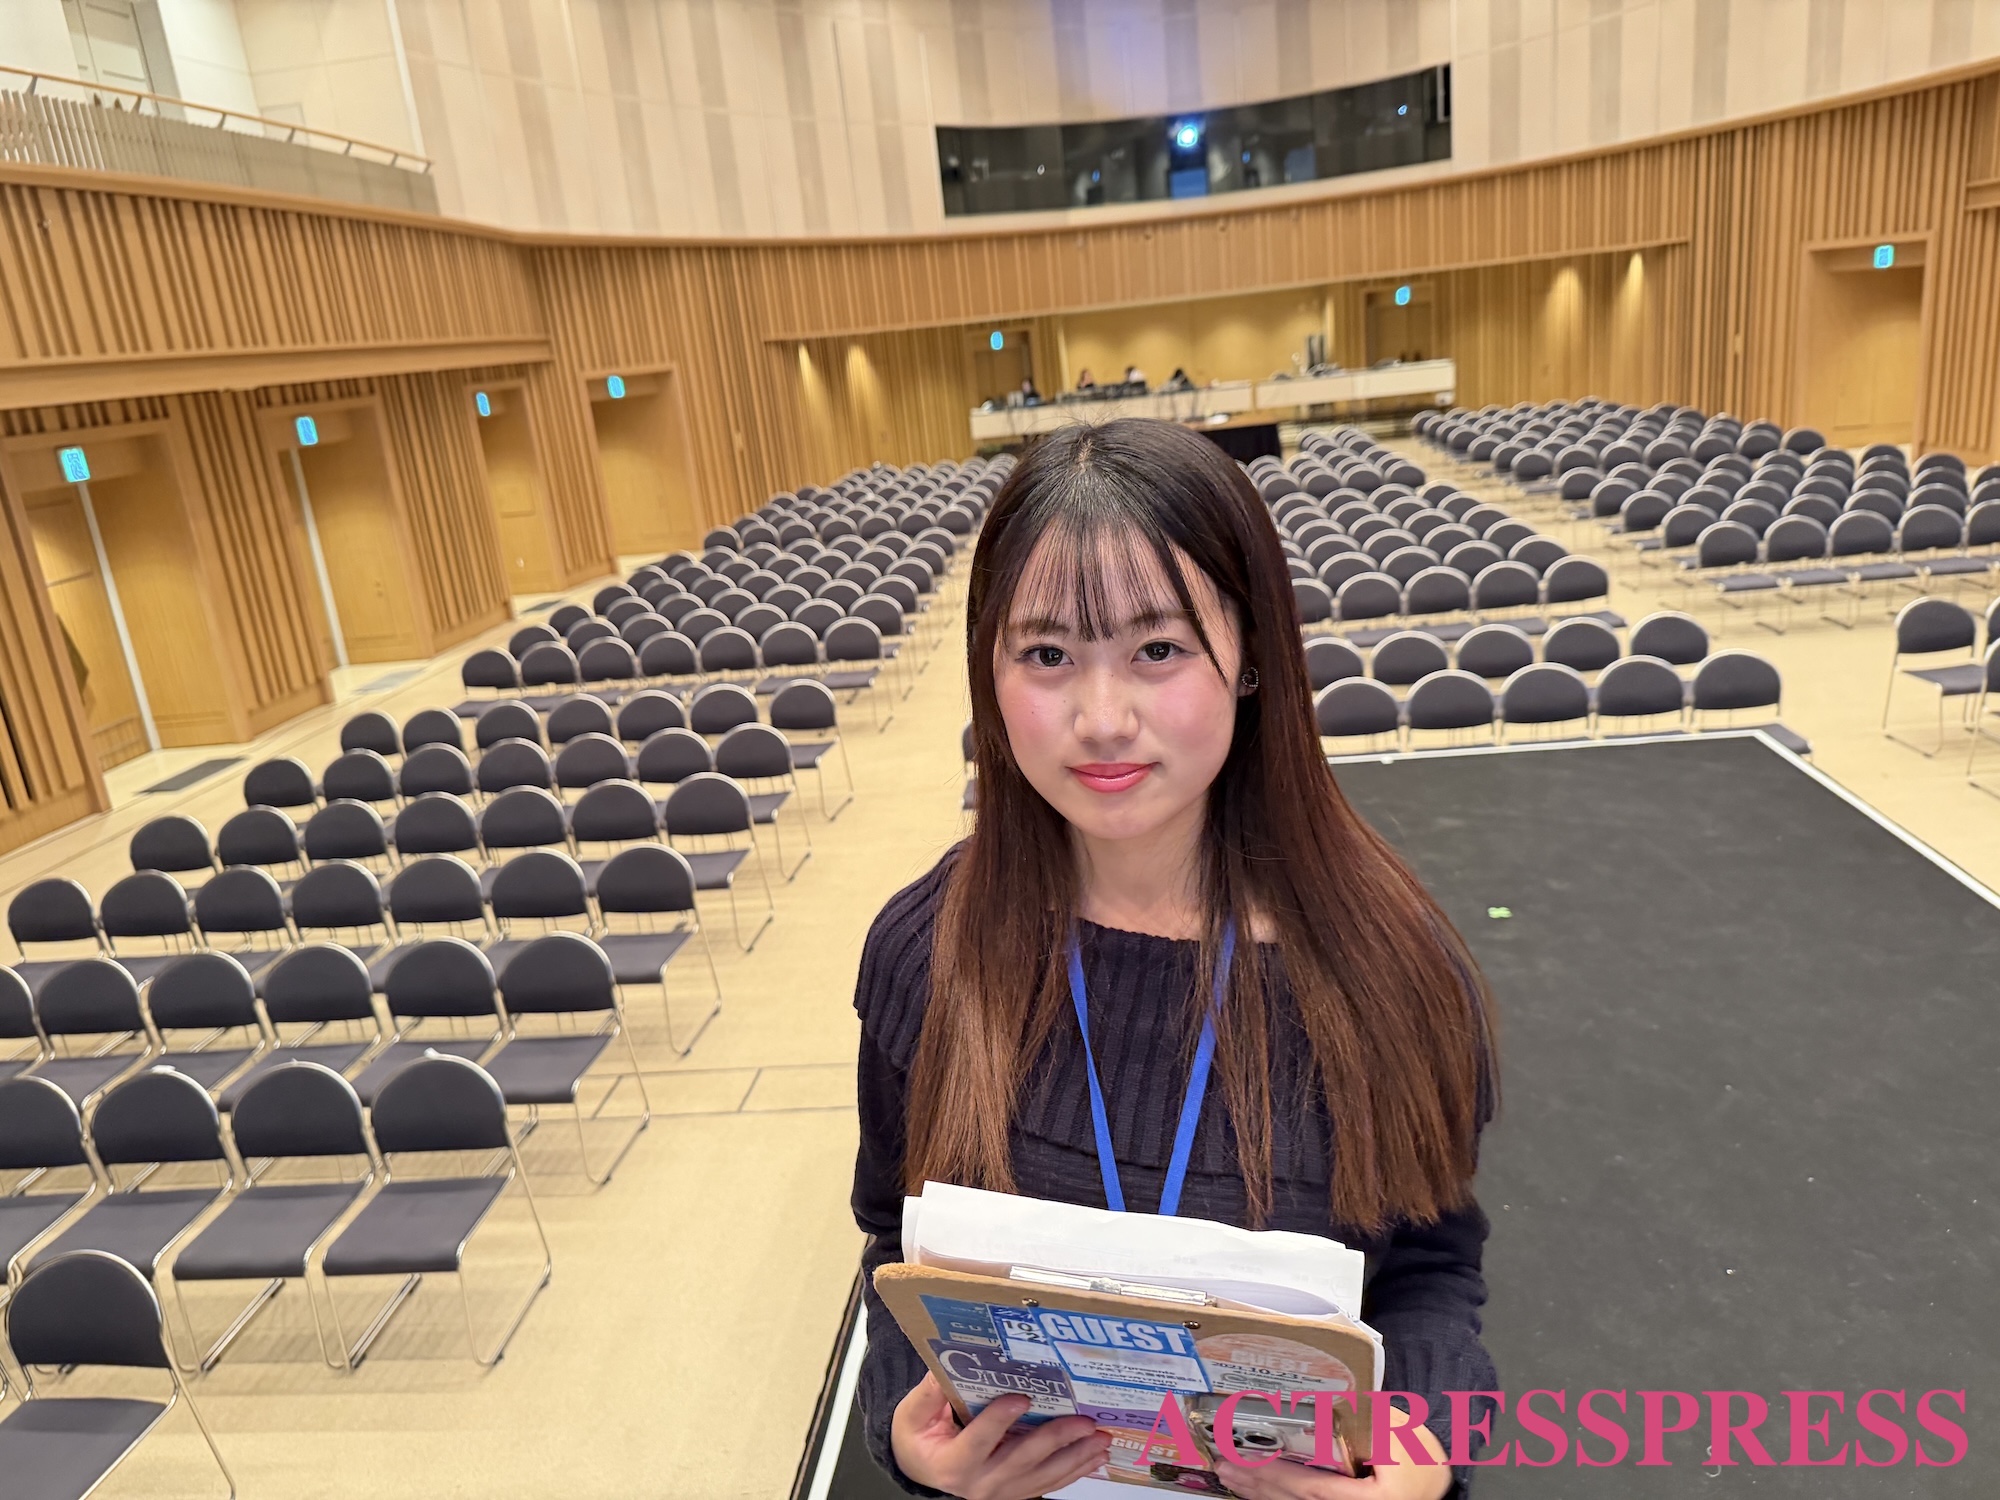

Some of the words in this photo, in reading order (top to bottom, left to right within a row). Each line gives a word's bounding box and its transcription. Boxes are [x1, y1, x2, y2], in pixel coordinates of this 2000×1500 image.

[1039, 1313, 1186, 1353] GUEST
[939, 1350, 1067, 1397] GUEST
[1231, 1350, 1313, 1374] GUEST
